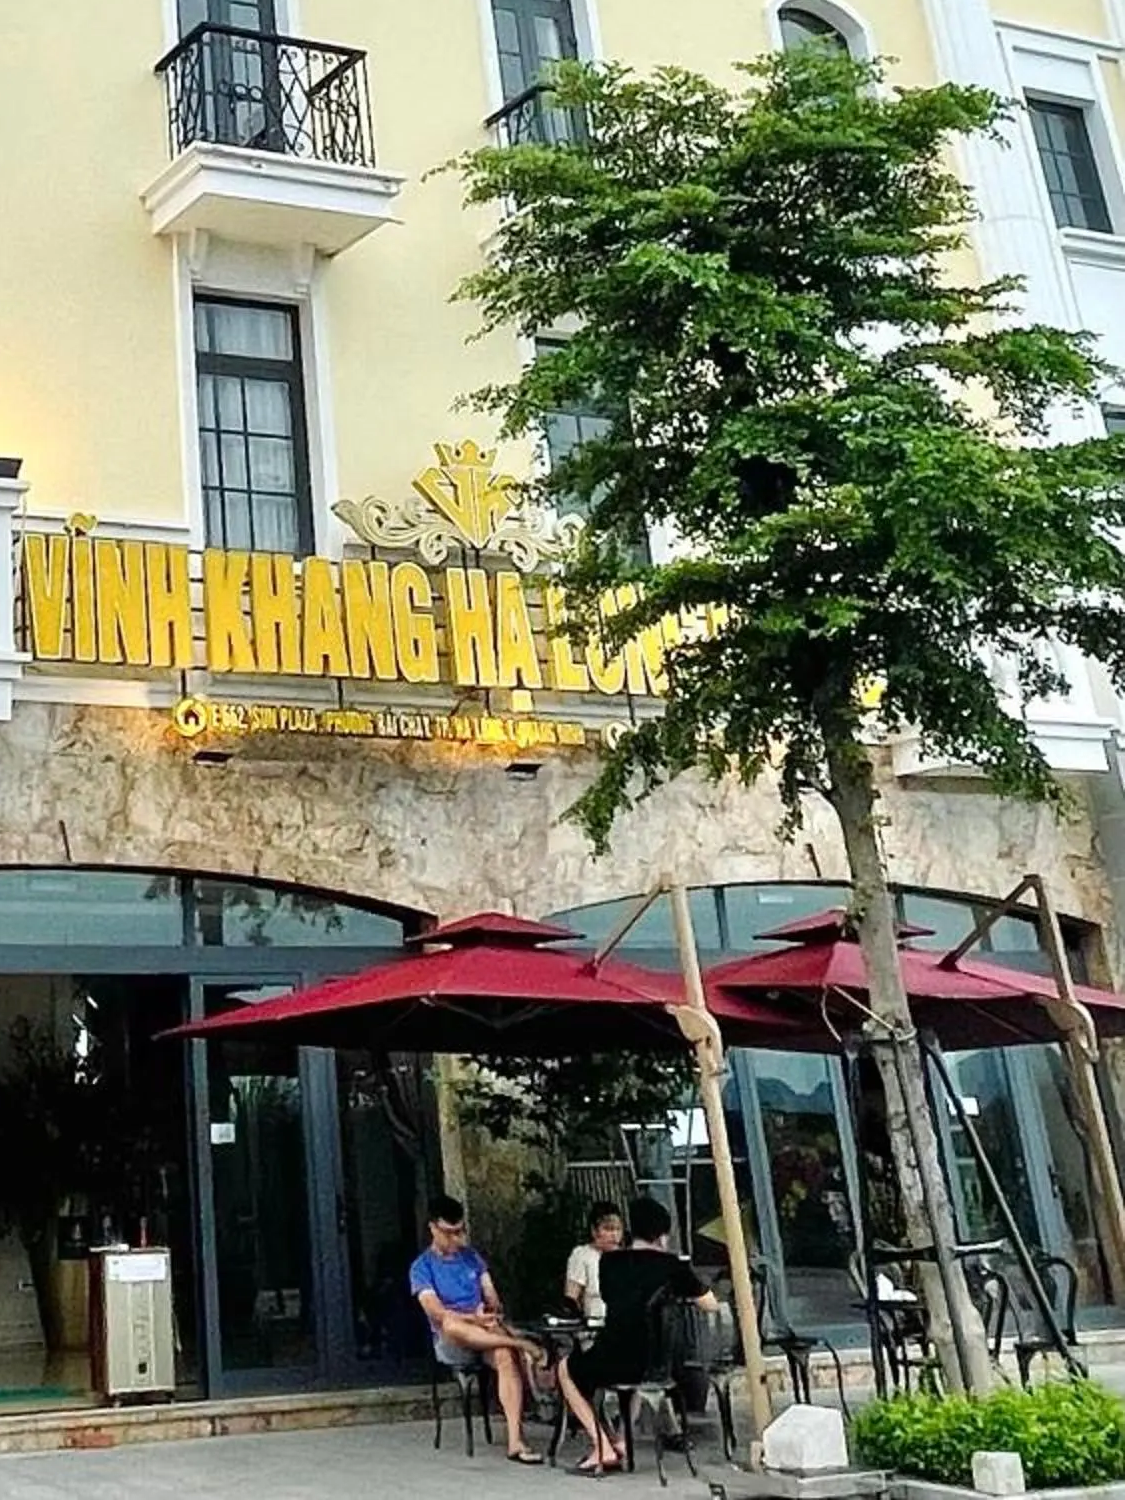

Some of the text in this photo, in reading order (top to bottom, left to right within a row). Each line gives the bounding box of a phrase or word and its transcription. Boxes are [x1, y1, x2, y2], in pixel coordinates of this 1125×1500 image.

[25, 512, 193, 670] VĨNH
[203, 547, 440, 683] KHANG
[445, 566, 543, 713] HẠ
